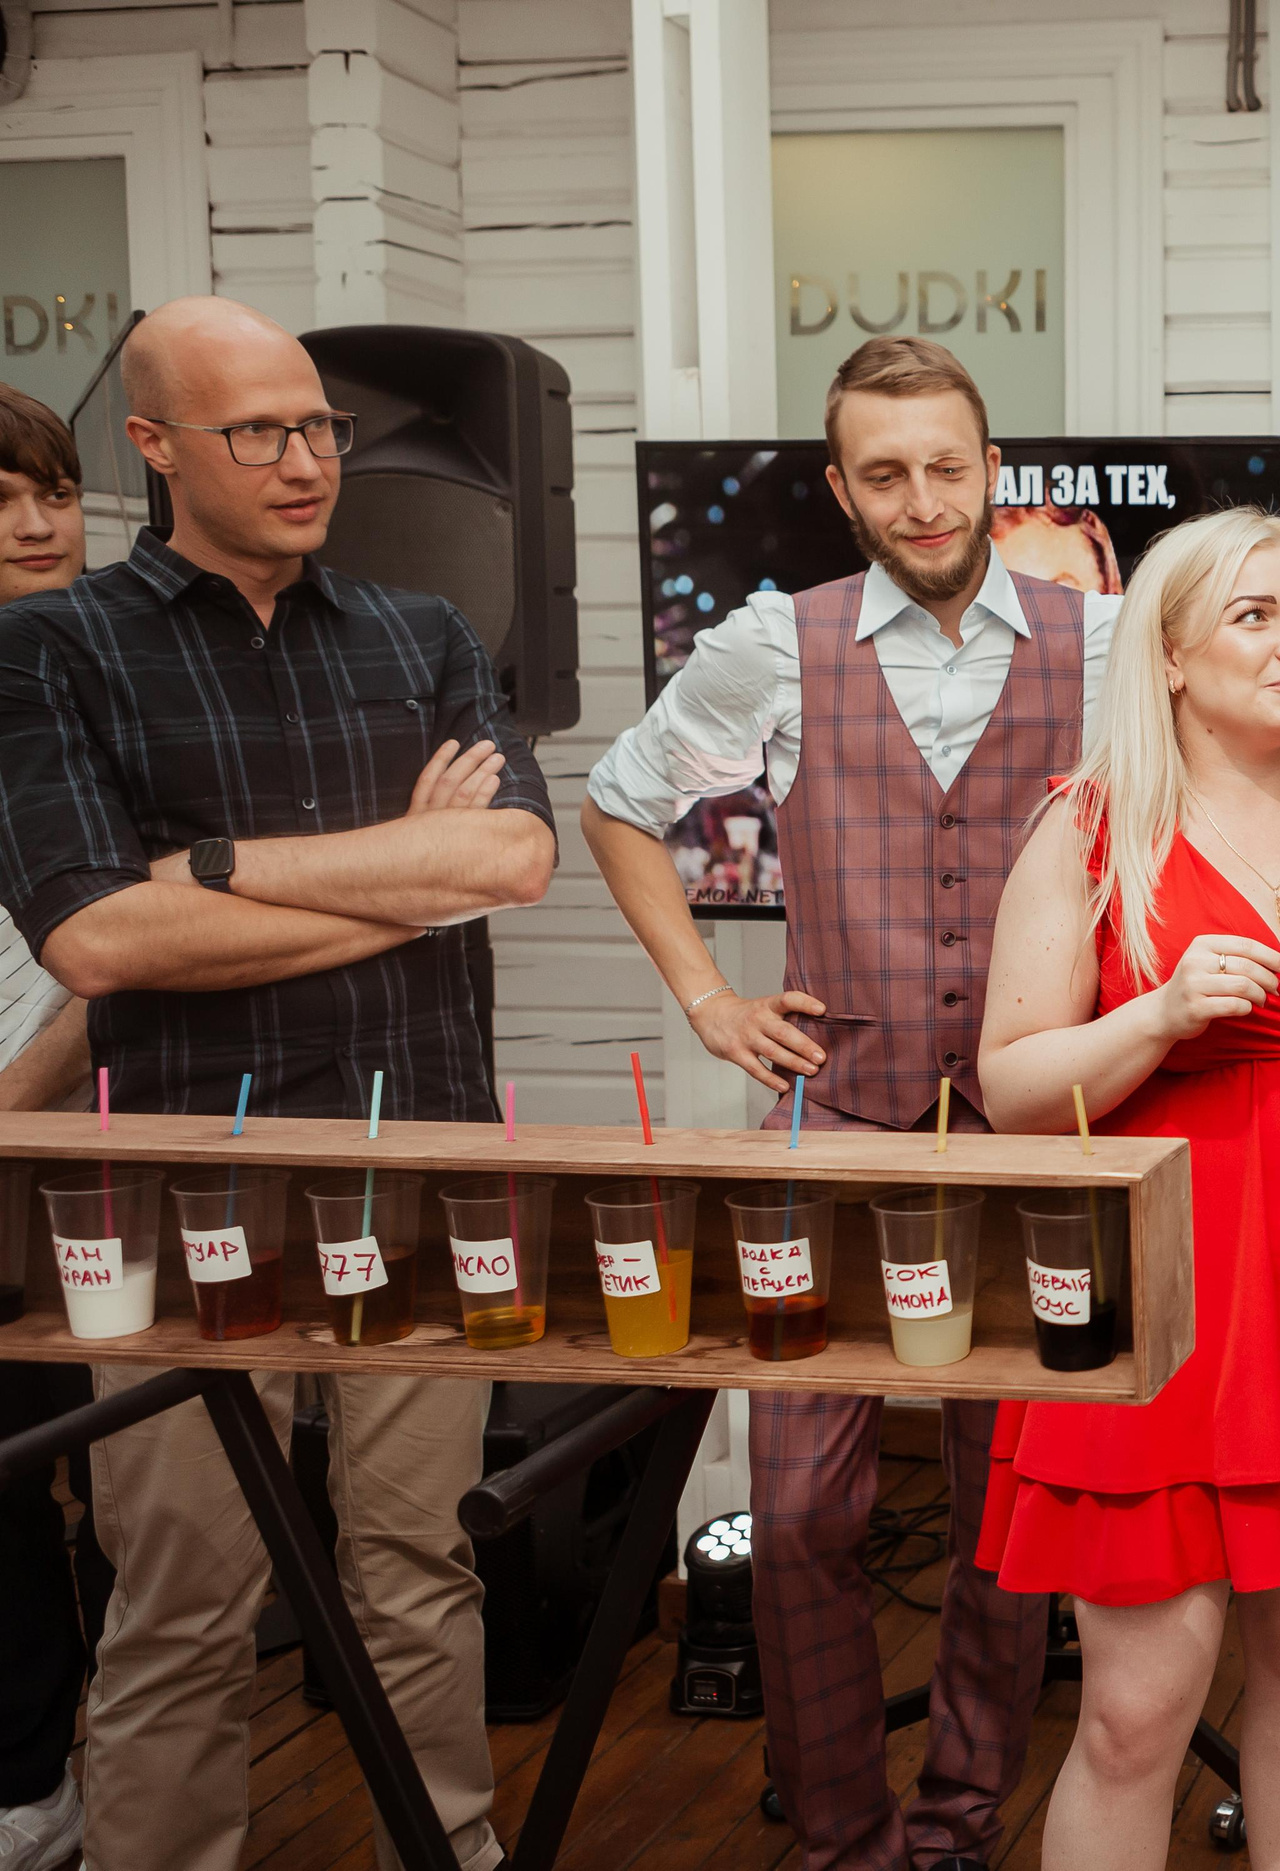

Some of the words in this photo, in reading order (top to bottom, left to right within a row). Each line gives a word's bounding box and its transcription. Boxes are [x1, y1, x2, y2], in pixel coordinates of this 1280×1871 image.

[790, 269, 1046, 336] DUDKI
[989, 465, 1044, 505] АЛ
[1051, 465, 1100, 506] ЗА
[1105, 465, 1176, 509] ТЕХ,
[319, 1250, 377, 1282] 777
[741, 1246, 802, 1261] ВОДКА
[885, 1265, 940, 1281] СОК
